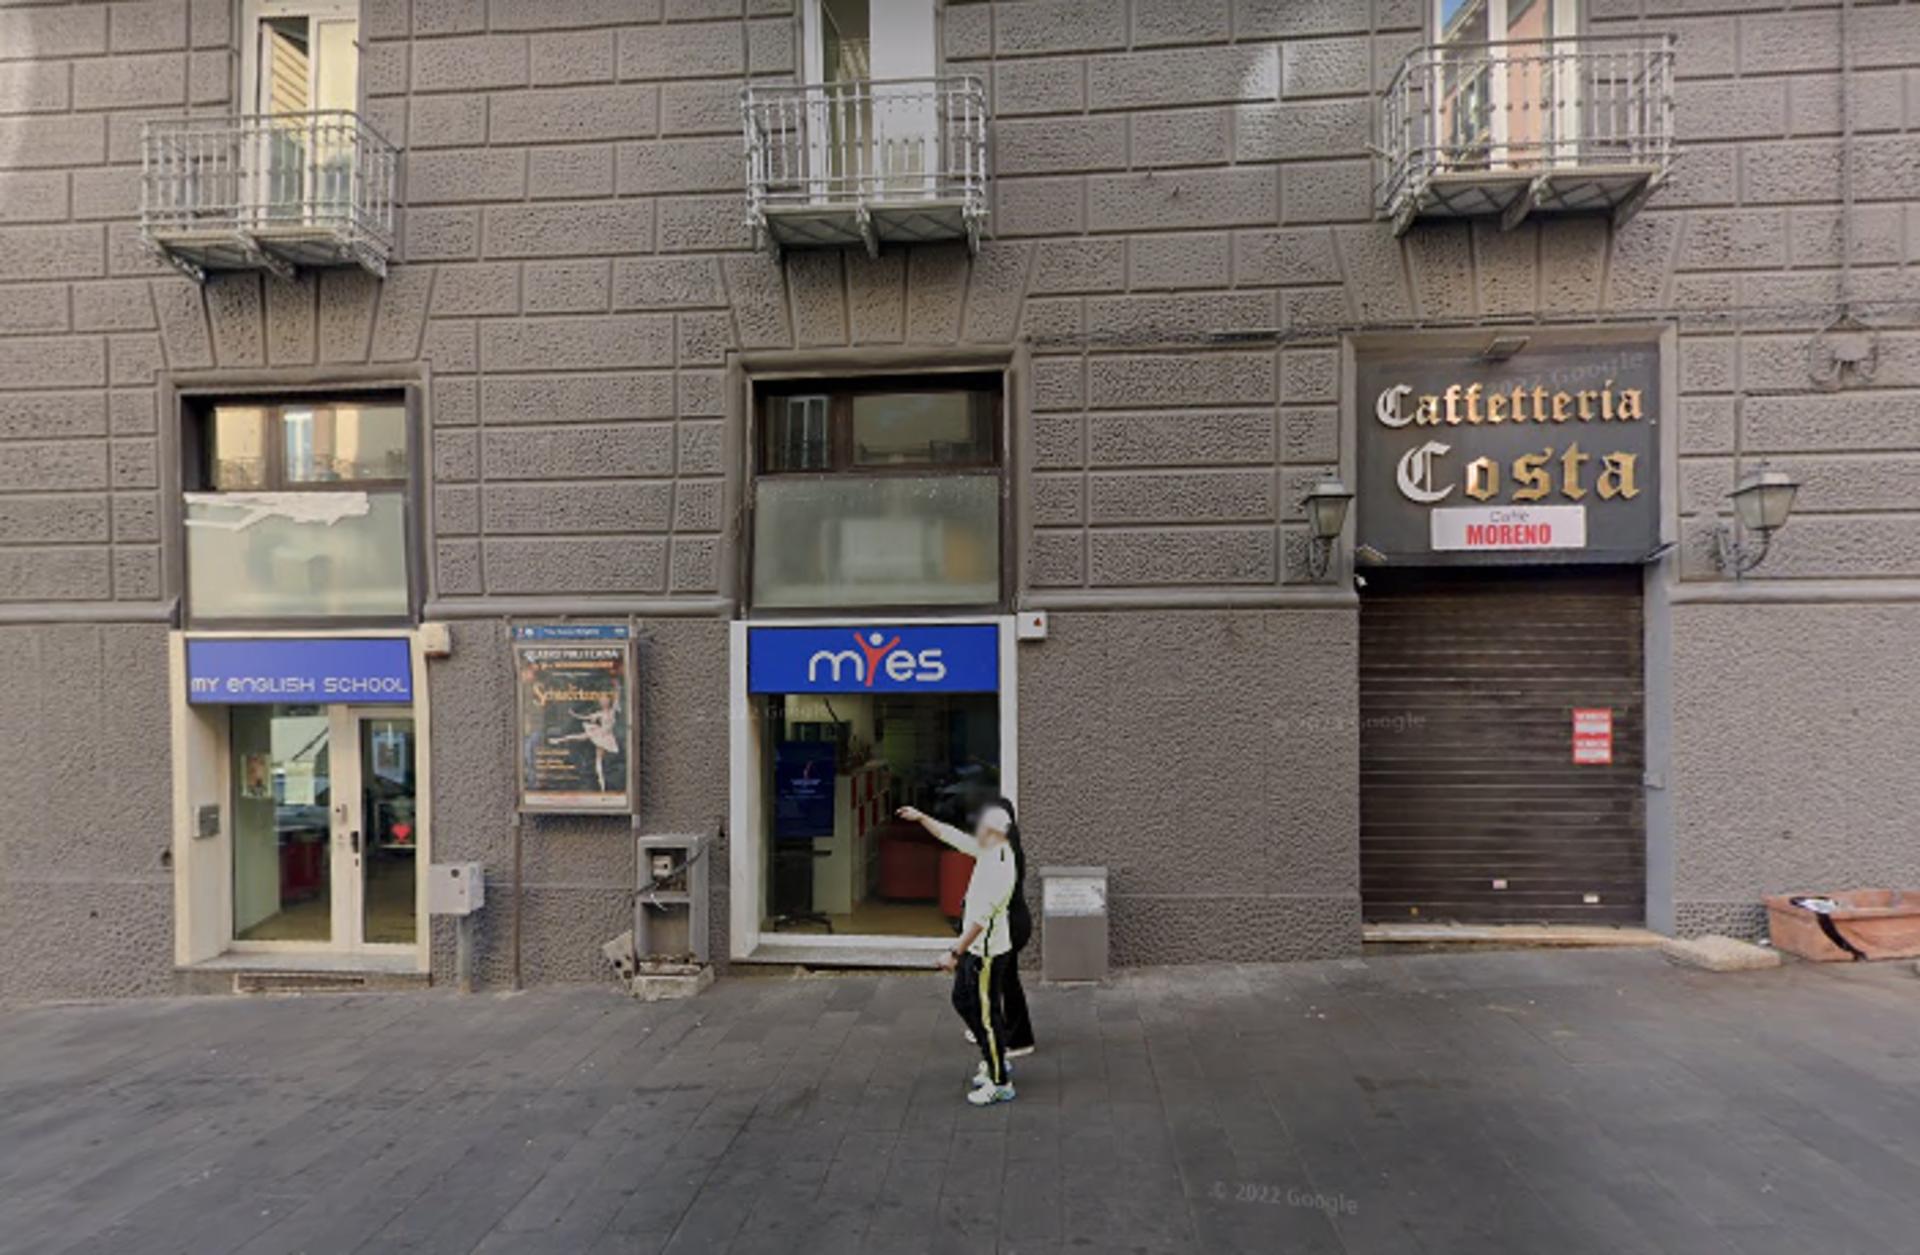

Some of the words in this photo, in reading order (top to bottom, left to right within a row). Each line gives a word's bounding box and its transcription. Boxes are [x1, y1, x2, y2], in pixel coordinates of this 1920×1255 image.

[1376, 379, 1643, 428] Caffetteria
[1396, 440, 1640, 503] Costa
[1466, 523, 1552, 545] MORENO
[323, 677, 407, 693] SCHOOL
